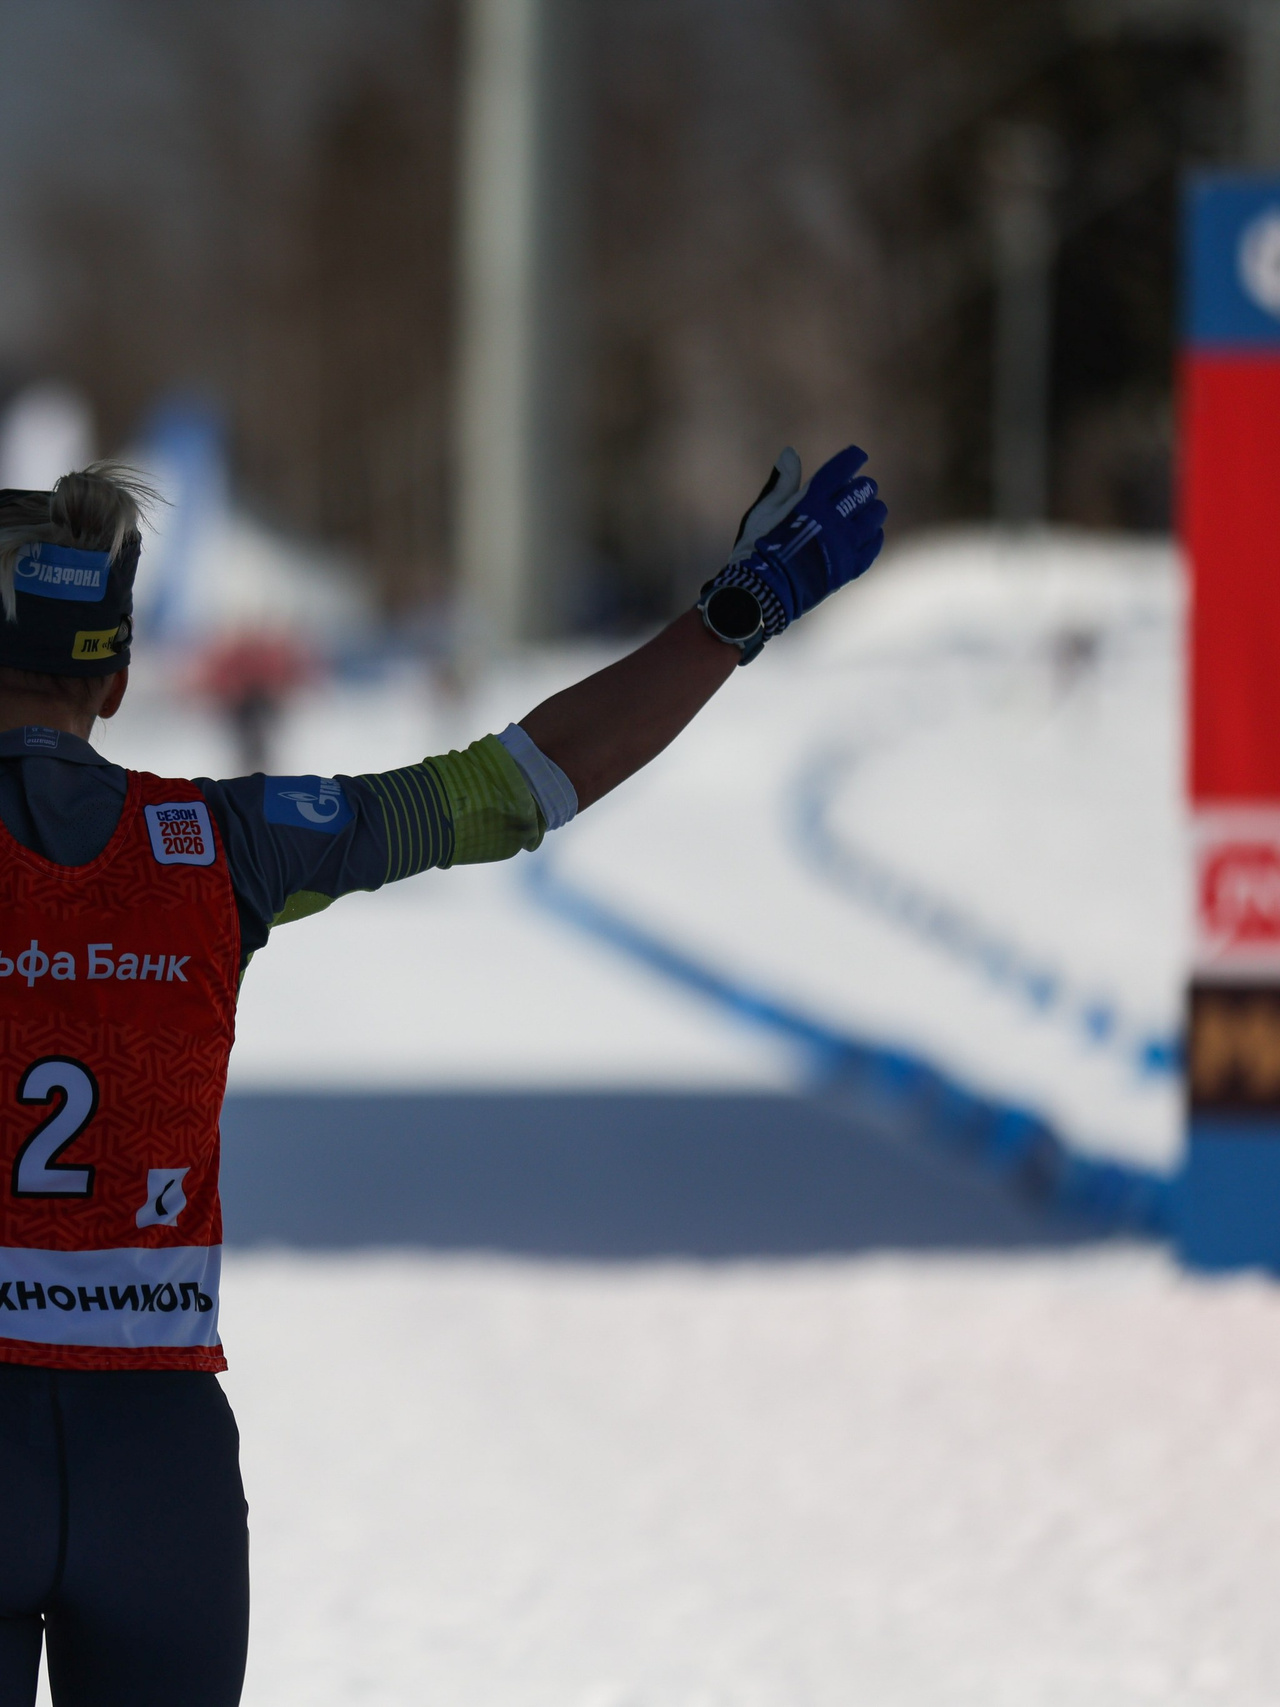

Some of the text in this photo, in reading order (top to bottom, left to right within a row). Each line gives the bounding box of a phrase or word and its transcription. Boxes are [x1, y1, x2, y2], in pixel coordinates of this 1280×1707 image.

[38, 563, 101, 588] ГАЗФОНД
[81, 638, 100, 653] ЛК
[156, 808, 198, 822] СЕЗОН
[158, 820, 202, 837] 2025
[163, 836, 206, 856] 2026
[86, 942, 192, 983] Банк
[15, 1055, 100, 1199] 2
